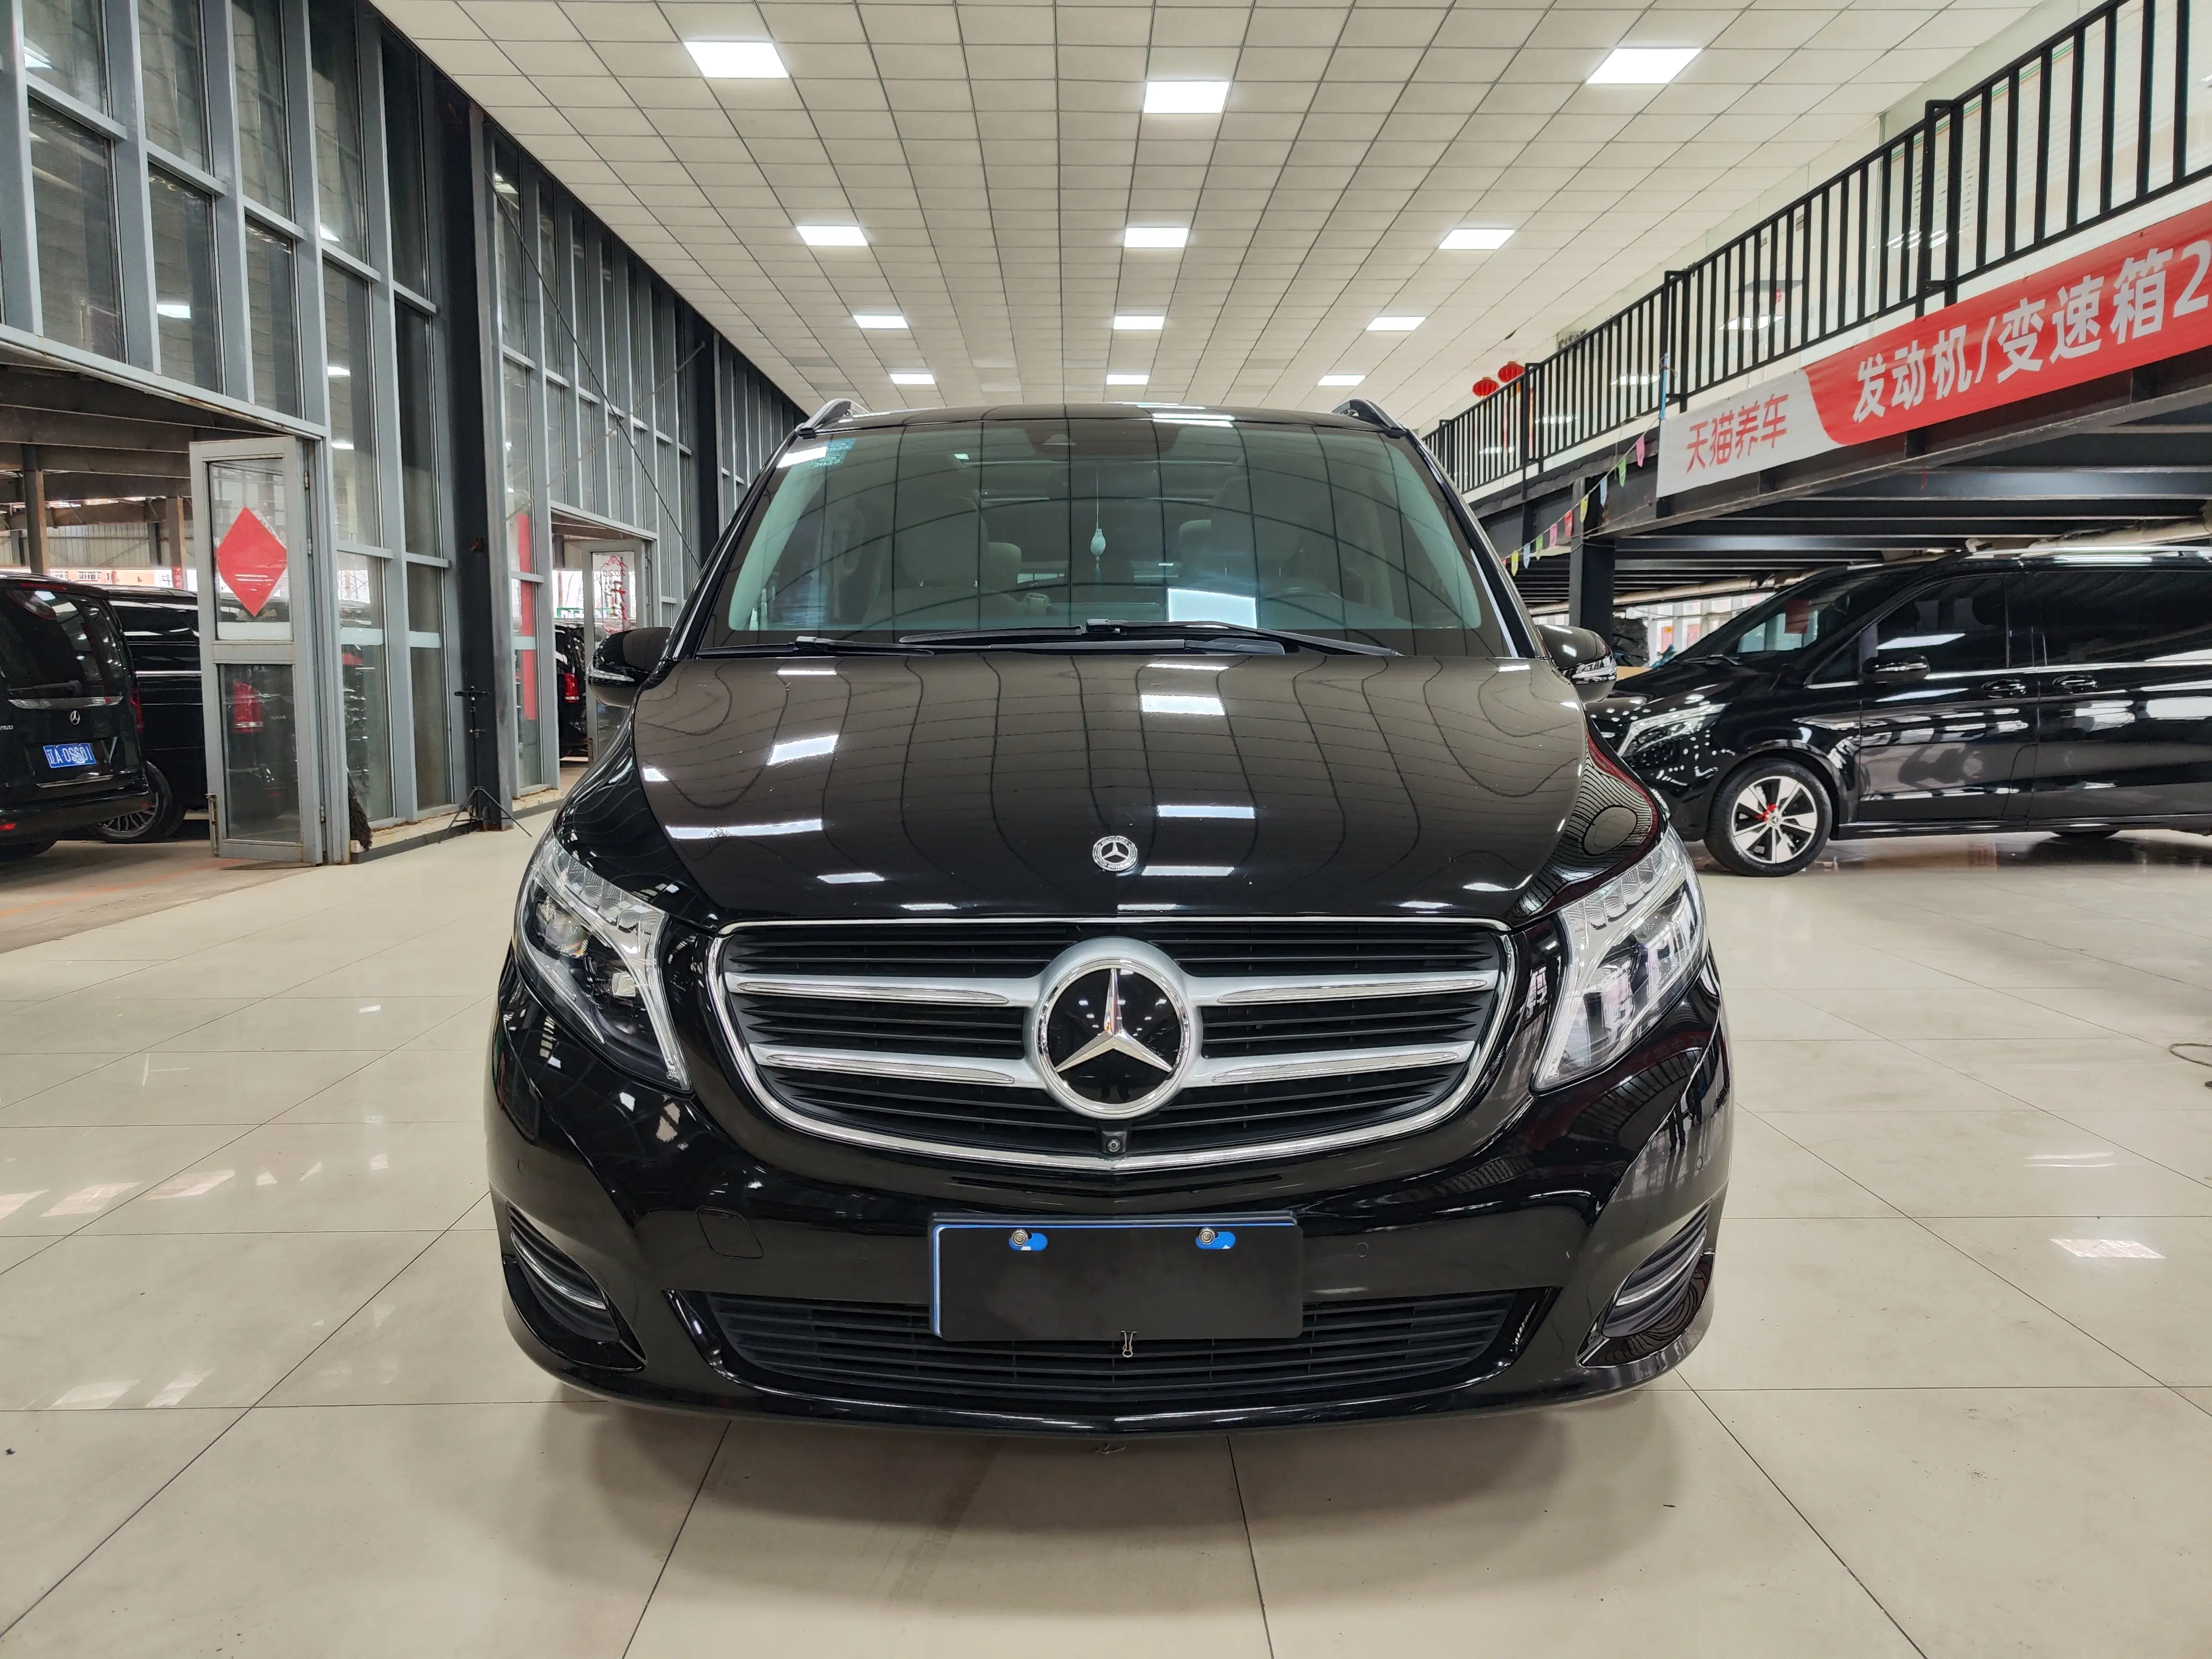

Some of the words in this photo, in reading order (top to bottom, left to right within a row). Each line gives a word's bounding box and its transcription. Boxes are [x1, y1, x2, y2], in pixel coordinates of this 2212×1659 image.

[1853, 239, 2212, 423] 发动机/变速箱2
[1686, 395, 1788, 473] 天猫养车
